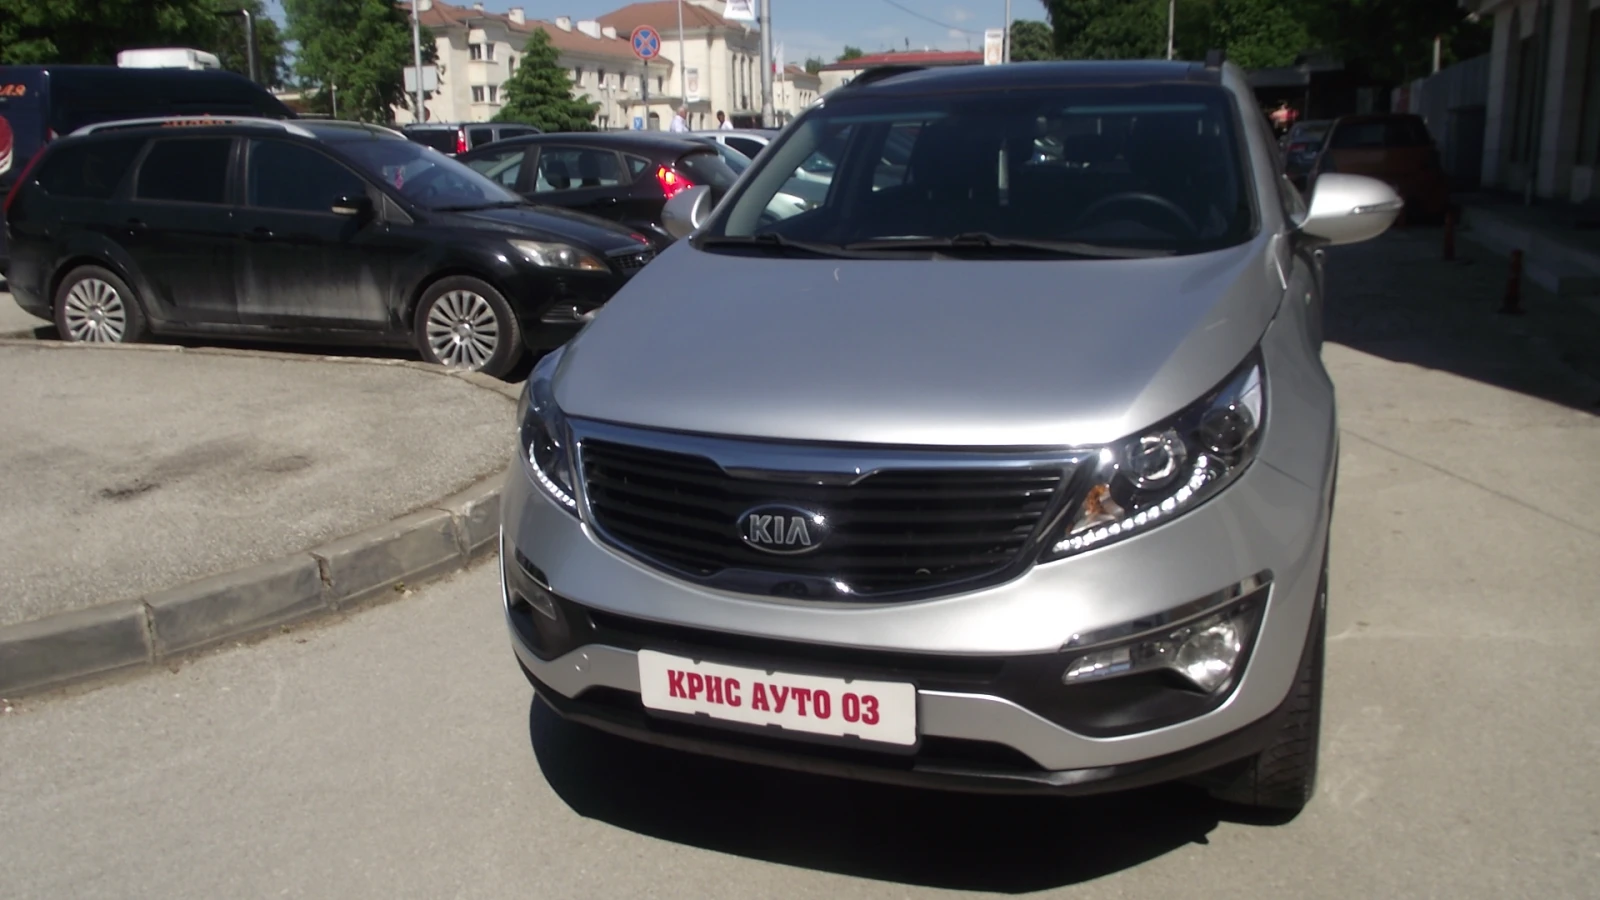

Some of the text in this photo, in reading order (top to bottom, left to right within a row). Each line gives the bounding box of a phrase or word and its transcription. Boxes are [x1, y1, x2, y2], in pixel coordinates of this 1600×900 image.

[749, 514, 811, 546] KIA
[667, 669, 880, 725] КРИС АУТО 03
